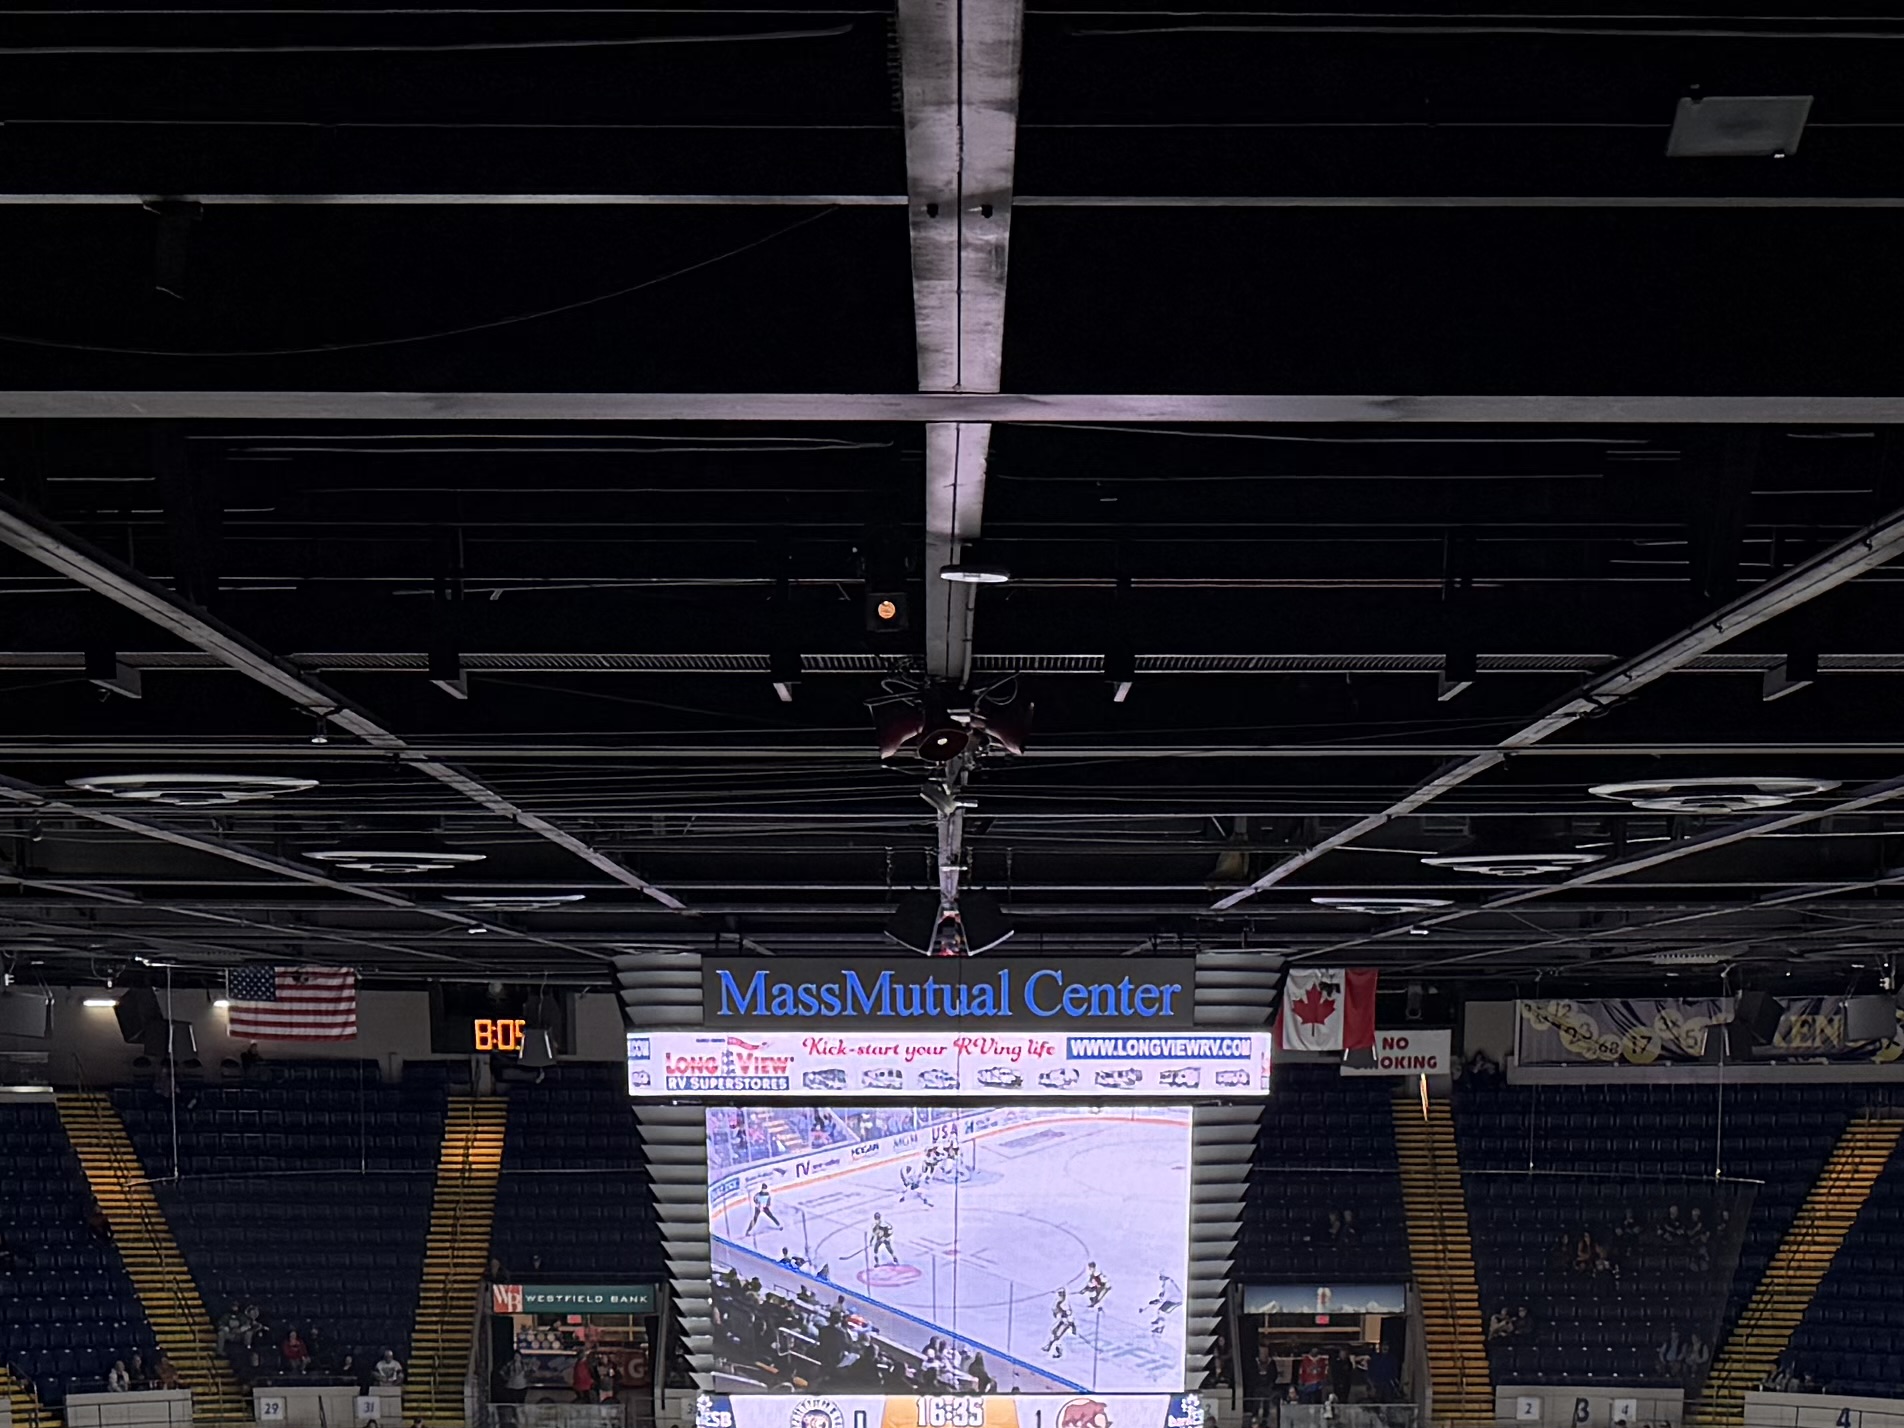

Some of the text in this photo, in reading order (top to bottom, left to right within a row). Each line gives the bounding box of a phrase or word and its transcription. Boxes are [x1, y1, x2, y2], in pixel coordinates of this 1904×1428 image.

[716, 969, 1182, 1017] MassMutual Center
[802, 1037, 1055, 1063] Kick-start your RVing life
[1070, 1038, 1251, 1057] WWW.LONGVIEWRV.COM
[1382, 1037, 1409, 1051] NO
[665, 1052, 790, 1075] LONG VIEW
[667, 1078, 788, 1090] RV SUPERSTORES
[525, 1294, 604, 1304] WESTFIELD
[610, 1294, 648, 1304] BANK
[264, 1402, 280, 1415] 29
[916, 1396, 984, 1428] 16:35
[1523, 1402, 1533, 1415] 2
